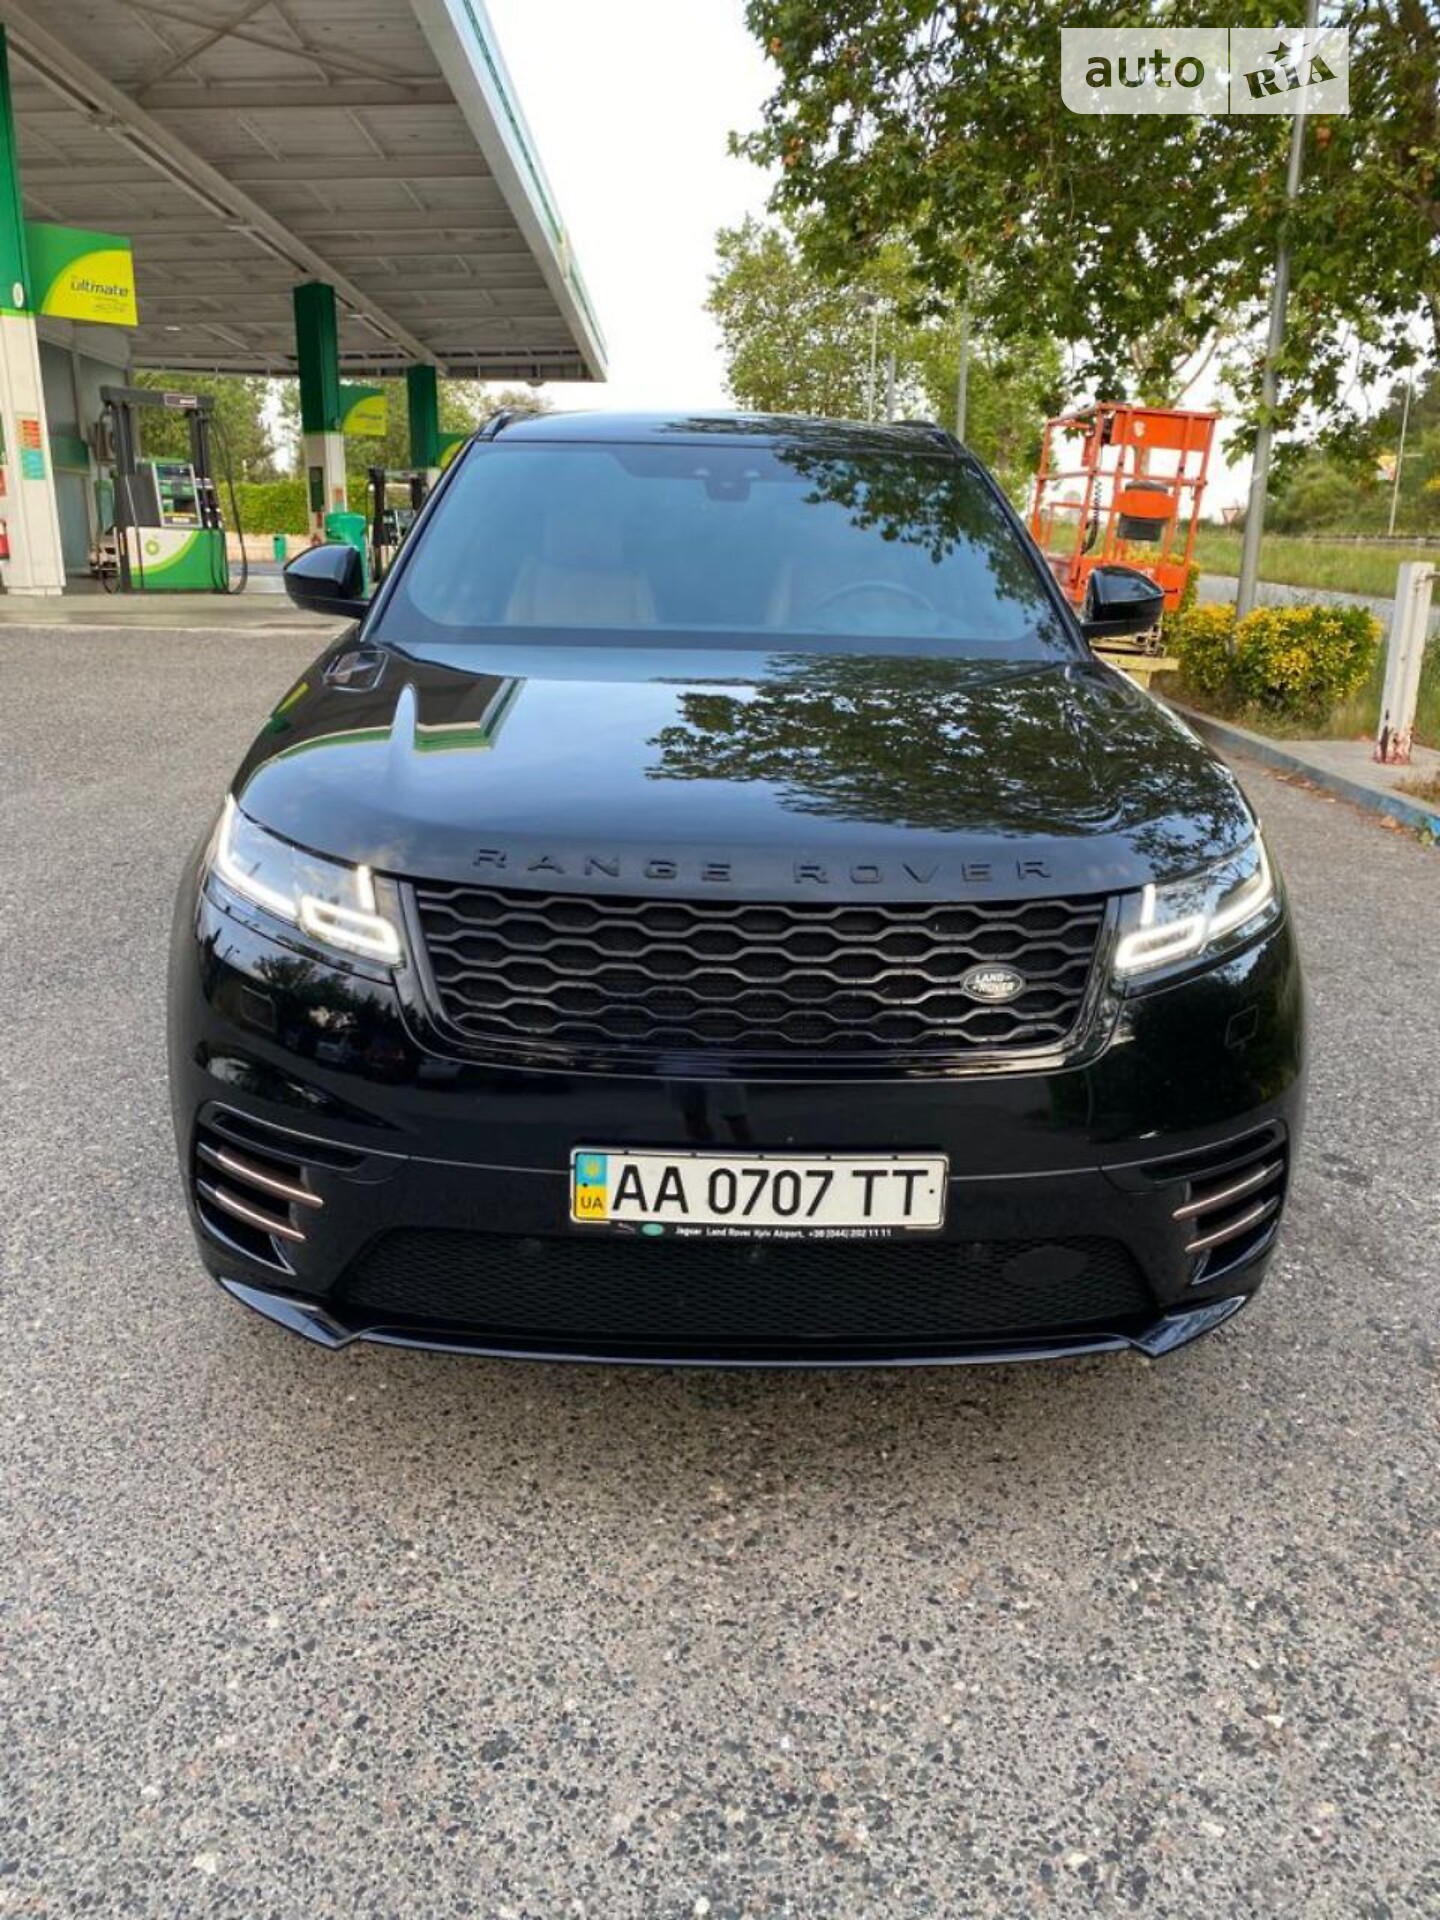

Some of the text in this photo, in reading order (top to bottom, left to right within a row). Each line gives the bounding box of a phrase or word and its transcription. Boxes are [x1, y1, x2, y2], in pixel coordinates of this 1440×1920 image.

[70, 278, 129, 298] ultimate
[473, 848, 1052, 885] RANGE ROVER
[612, 1164, 929, 1217] AA 0707 TT
[580, 1196, 604, 1211] UA
[706, 1226, 727, 1237] Land
